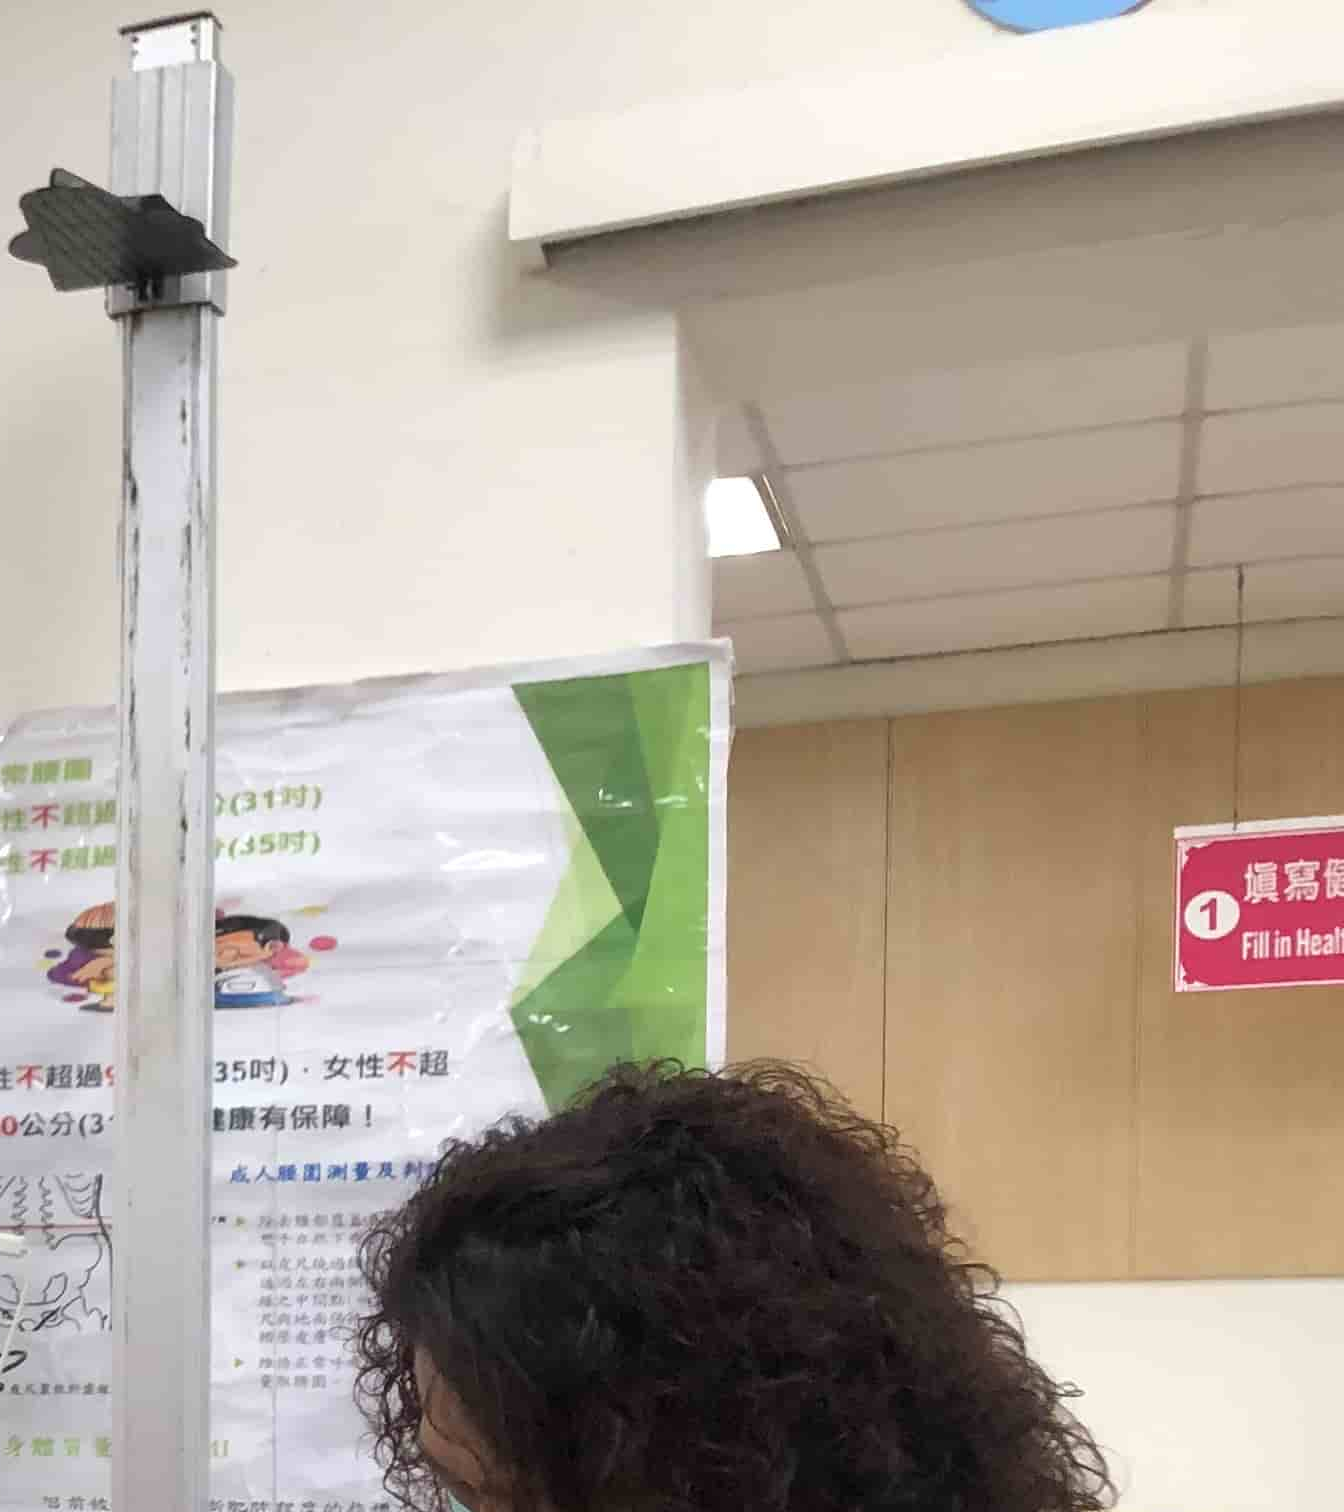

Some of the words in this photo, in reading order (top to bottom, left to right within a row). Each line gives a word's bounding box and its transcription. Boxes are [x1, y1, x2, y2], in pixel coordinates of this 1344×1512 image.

[1199, 897, 1219, 931] 1
[1241, 930, 1270, 960] Fill
[1273, 929, 1292, 958] in
